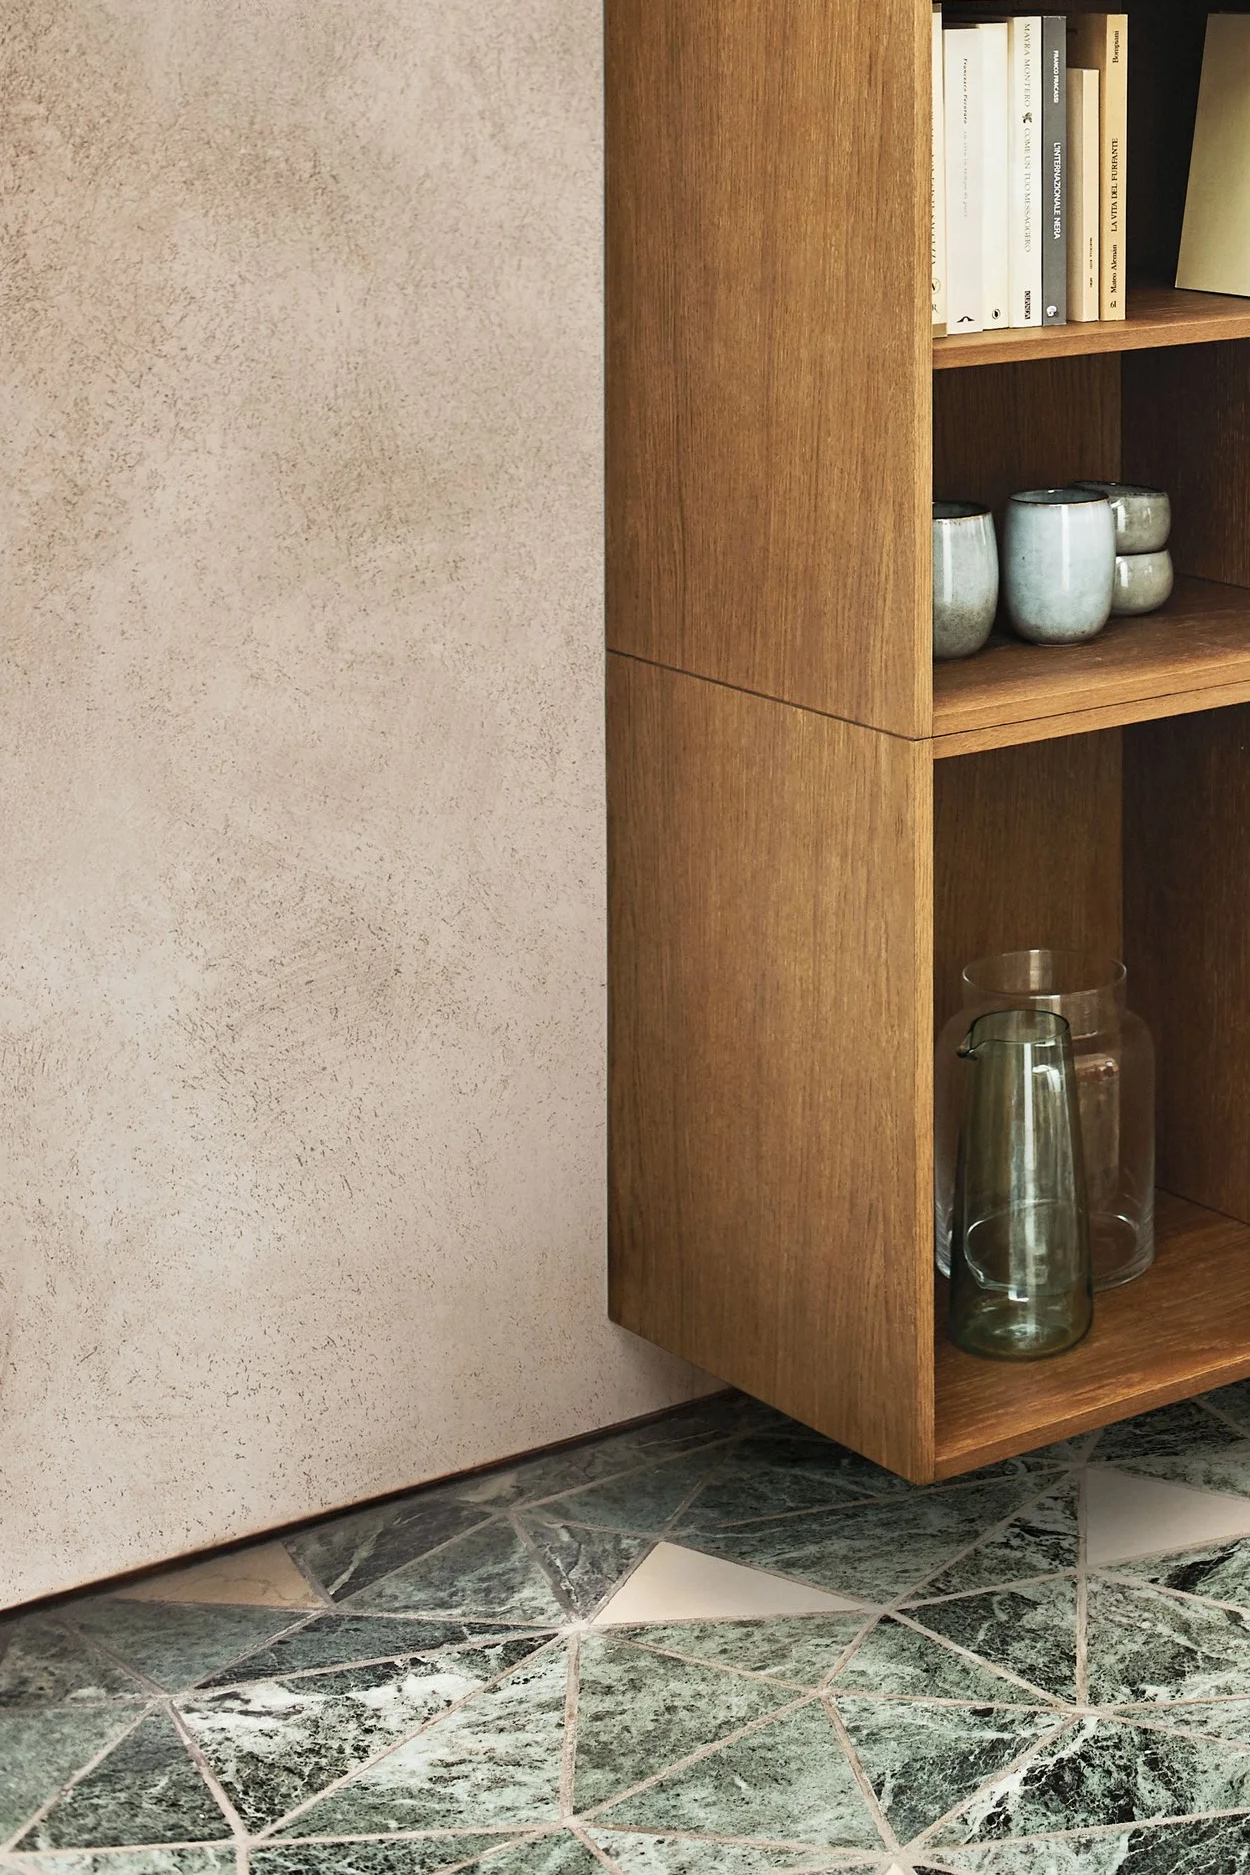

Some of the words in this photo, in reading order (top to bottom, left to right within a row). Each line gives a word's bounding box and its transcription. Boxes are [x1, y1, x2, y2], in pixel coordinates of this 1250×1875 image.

[1023, 23, 1031, 56] MAYRA
[1111, 30, 1121, 64] Bompiani
[1023, 58, 1031, 108] MONTERO
[1023, 127, 1031, 154] COME
[1024, 155, 1031, 170] UN
[1023, 172, 1031, 192] TUO
[1053, 142, 1062, 216] L'INTERNAZIONALE
[1110, 183, 1118, 199] DEL
[1110, 201, 1118, 220] VITA
[1053, 217, 1061, 240] NERA
[1110, 220, 1118, 232] LA
